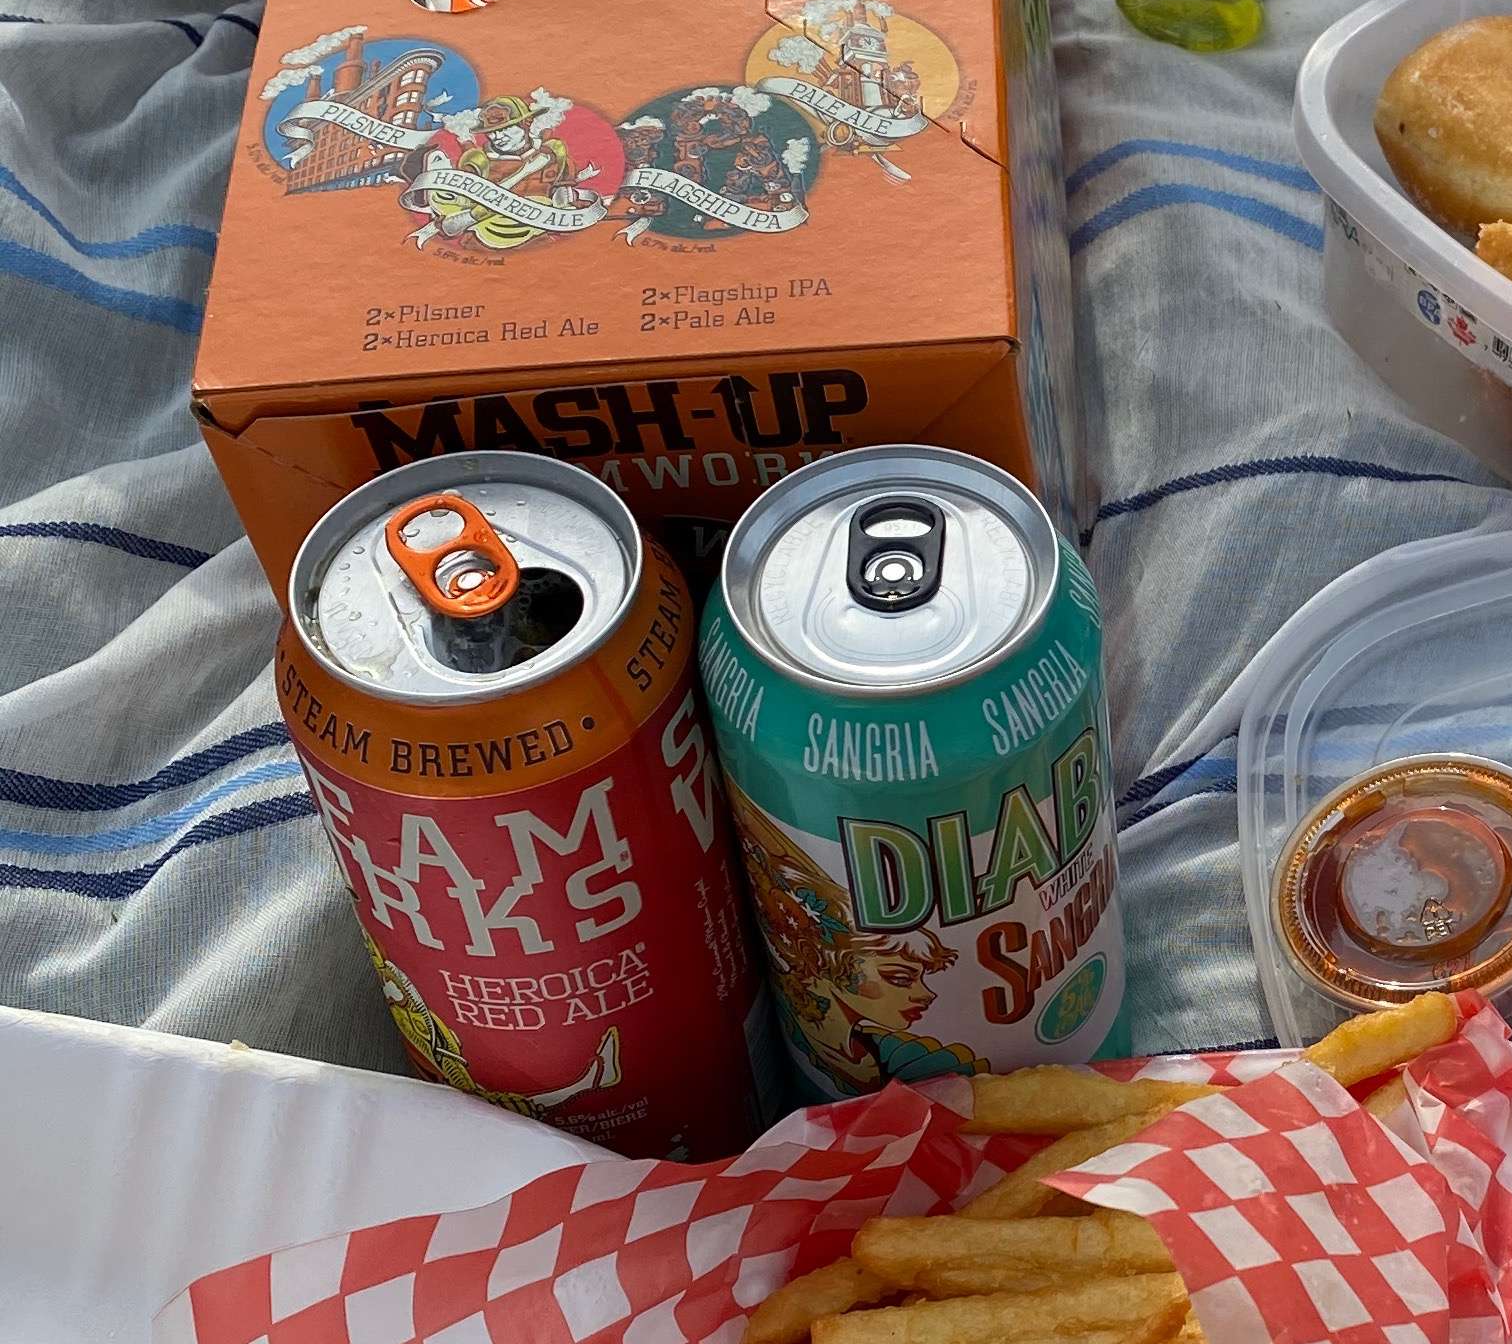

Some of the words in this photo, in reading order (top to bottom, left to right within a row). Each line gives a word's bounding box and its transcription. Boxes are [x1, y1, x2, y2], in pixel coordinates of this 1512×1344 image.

[320, 105, 405, 145] PILSNER
[791, 82, 842, 120] PALE
[845, 109, 893, 135] ALE
[502, 195, 542, 222] RED
[543, 210, 584, 228] ALE
[634, 169, 741, 224] FLAGSHIP
[742, 211, 782, 230] IPA
[735, 306, 776, 327] Ale
[787, 277, 833, 298] IPA
[500, 320, 549, 342] Red
[559, 317, 600, 338] Ale
[351, 367, 870, 474] MASH-UP
[626, 573, 682, 693] STEAM
[701, 617, 765, 743] SANGRIA
[982, 640, 1088, 755] SANGRIA
[281, 663, 371, 765] STEAM
[390, 718, 574, 778] BREWED
[804, 713, 939, 782] SANGRIA
[449, 998, 546, 1031] RED
[562, 970, 654, 1026] ALE
